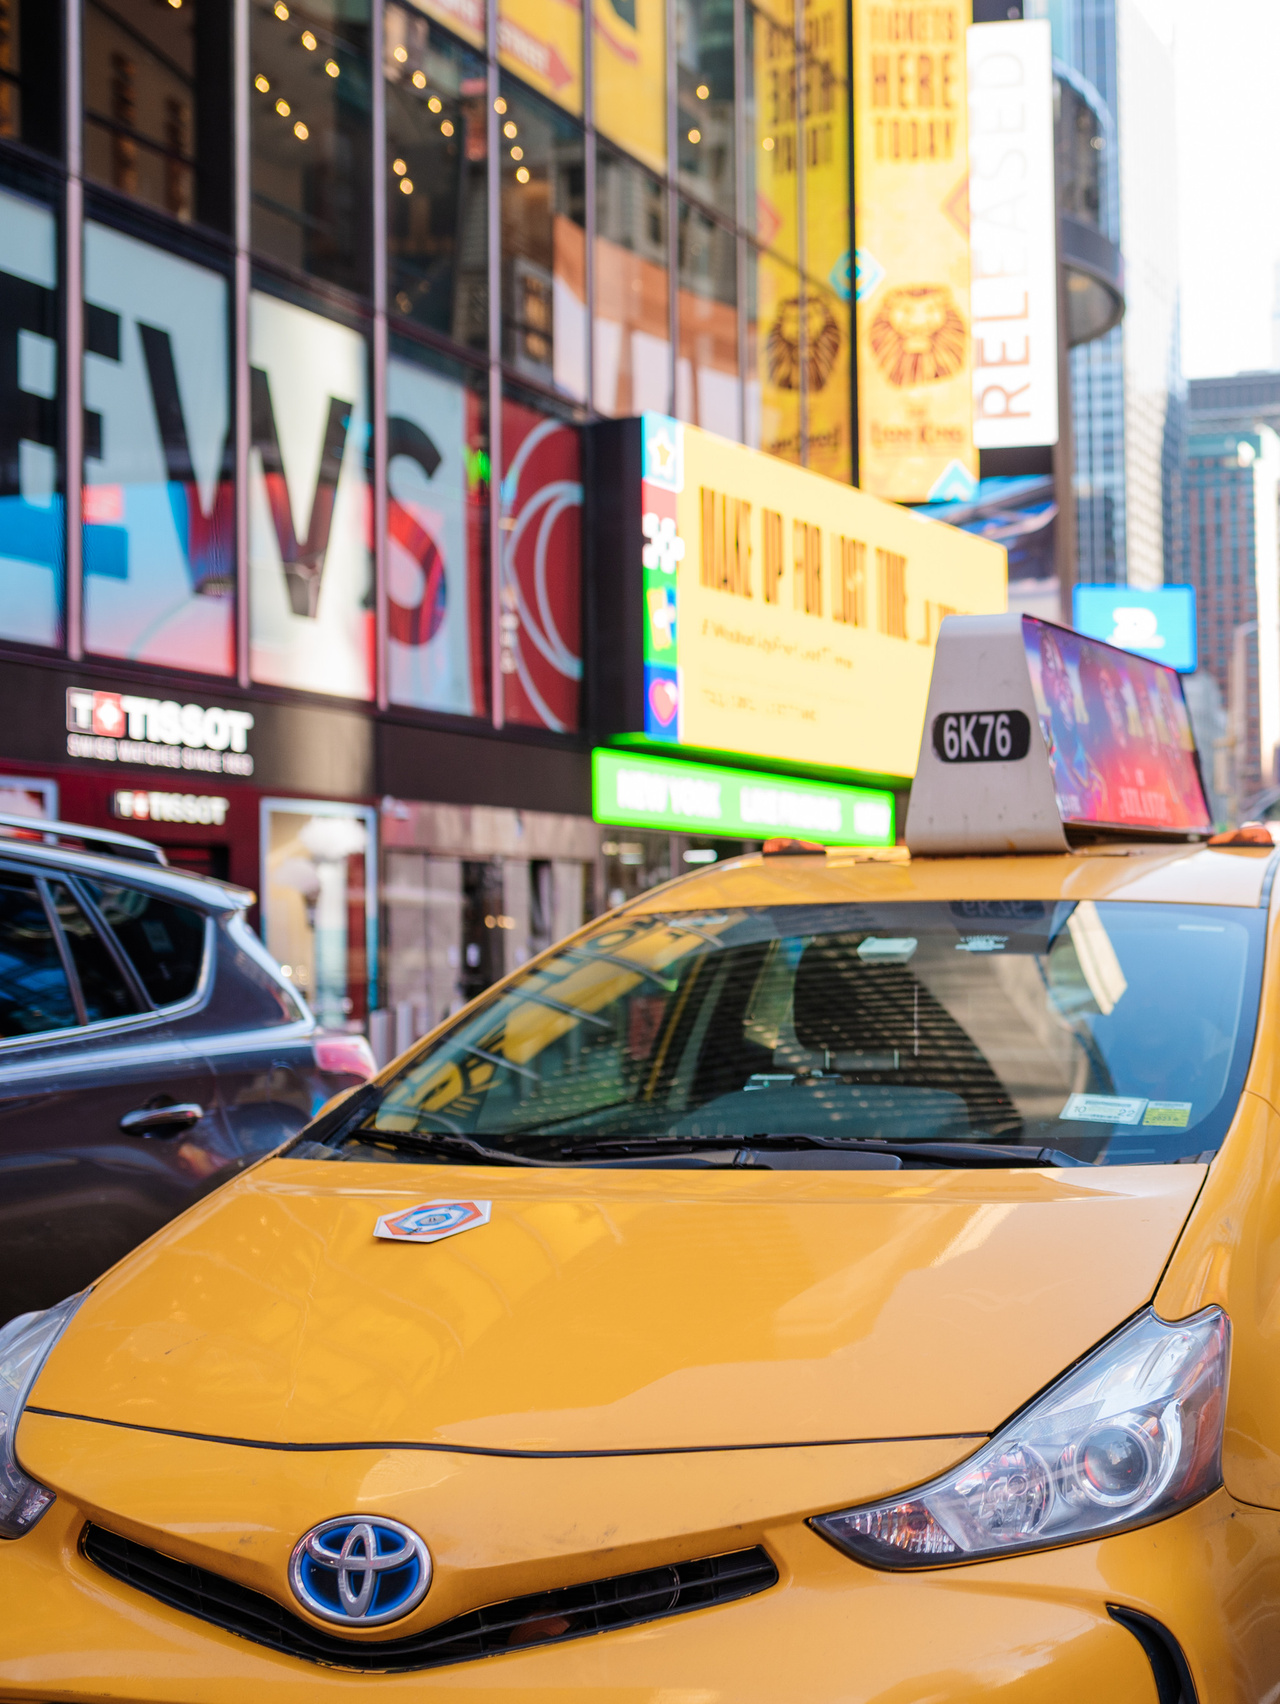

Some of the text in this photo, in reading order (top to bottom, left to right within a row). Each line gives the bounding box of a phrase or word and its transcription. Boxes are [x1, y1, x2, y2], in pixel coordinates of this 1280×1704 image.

[872, 53, 954, 109] HERE
[874, 117, 954, 162] TODAY
[978, 52, 1031, 420] RELEASED
[119, 694, 254, 753] TISSOT
[943, 714, 1013, 759] 6K76
[150, 791, 230, 825] TISSOT
[1118, 1109, 1136, 1117] 22
